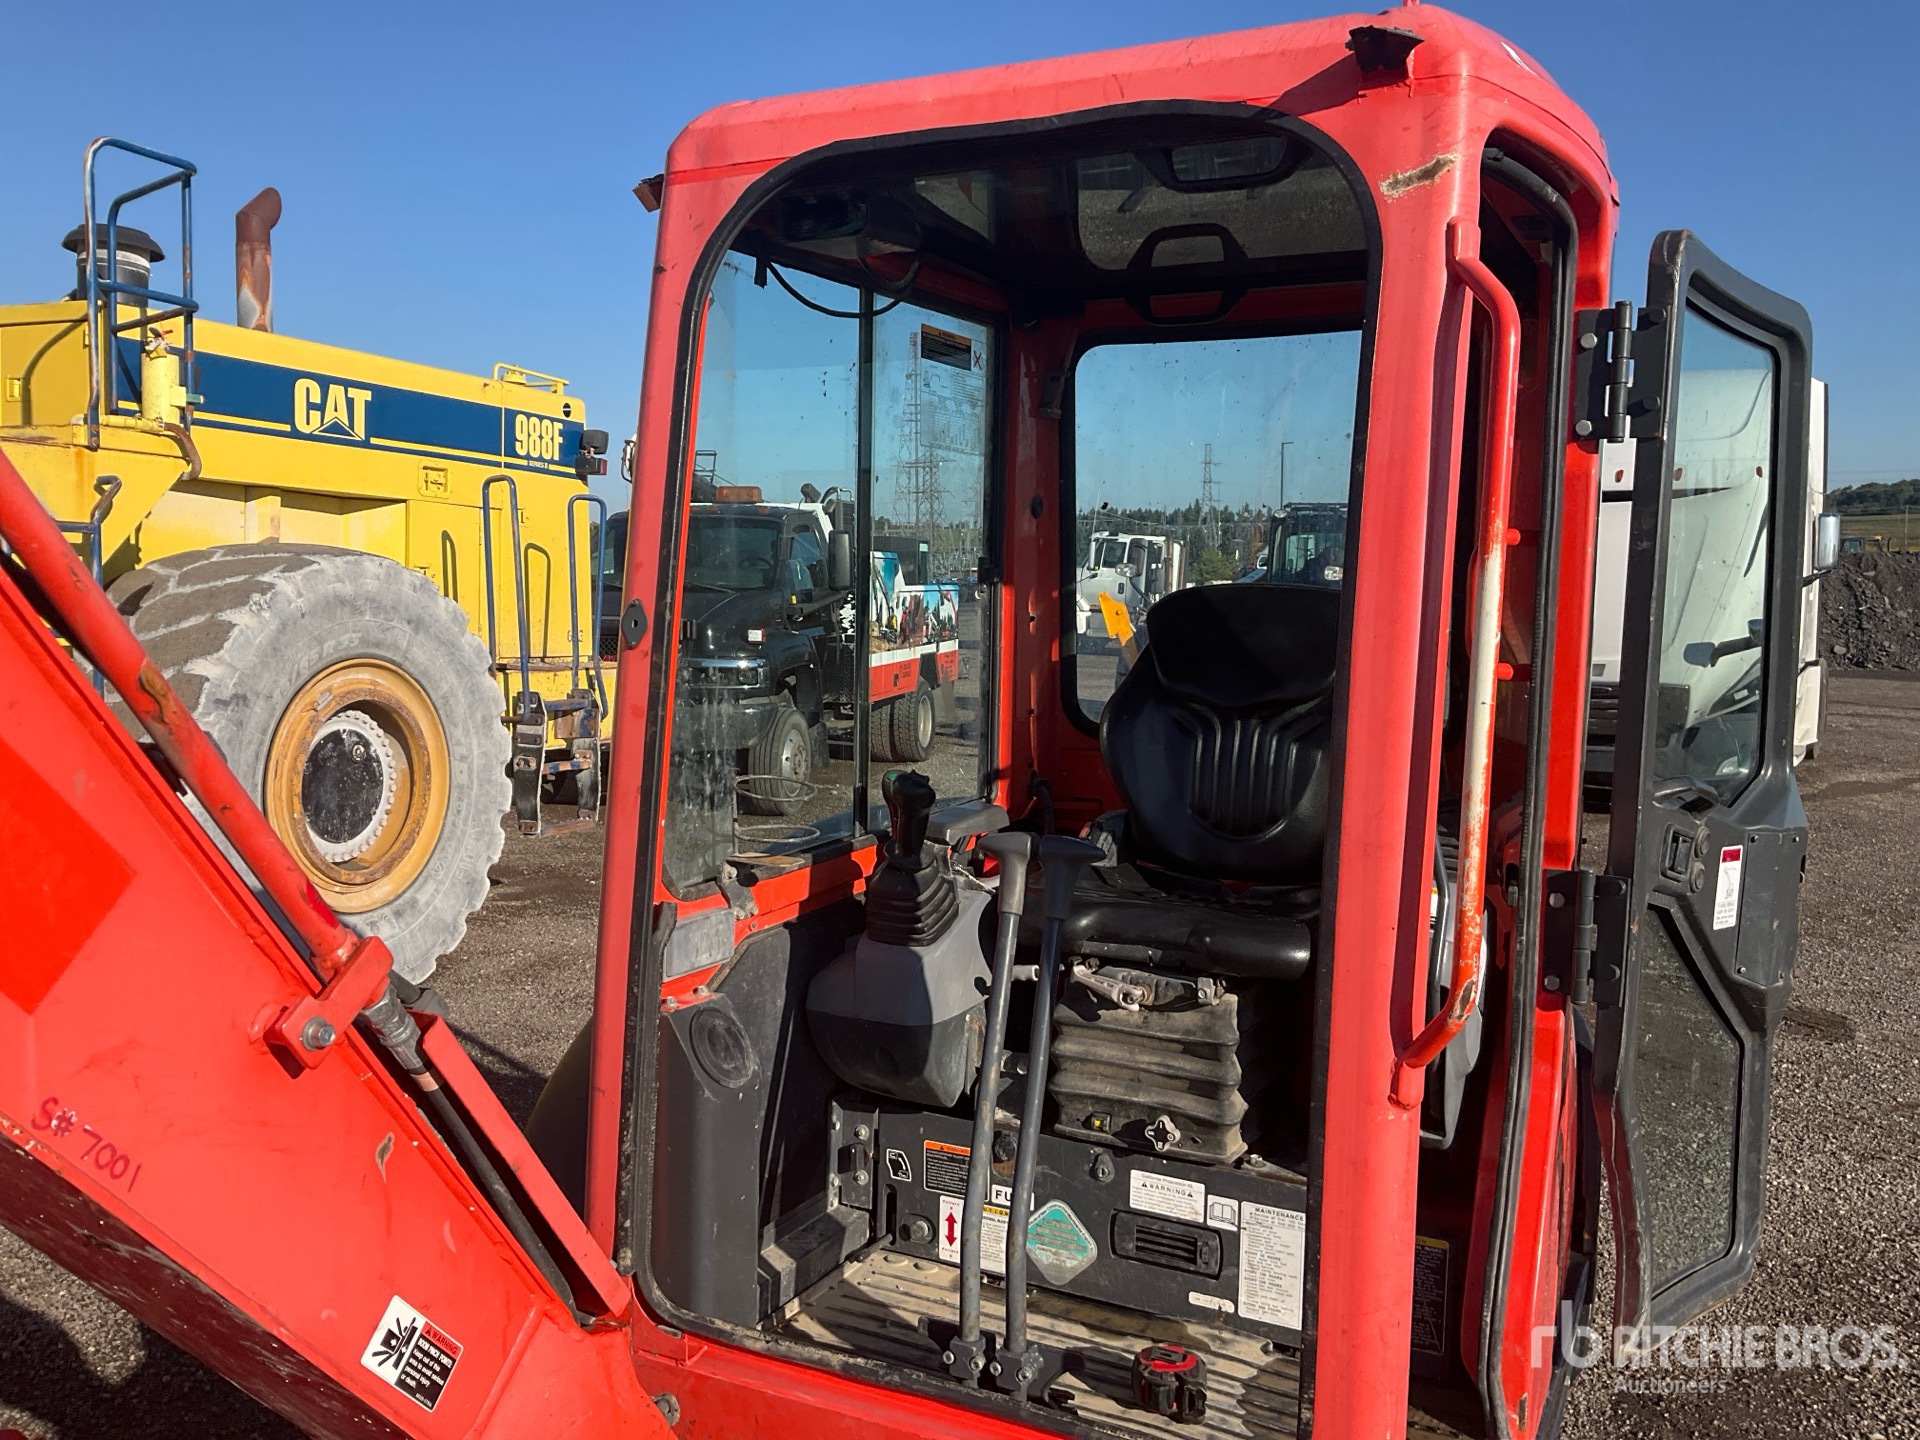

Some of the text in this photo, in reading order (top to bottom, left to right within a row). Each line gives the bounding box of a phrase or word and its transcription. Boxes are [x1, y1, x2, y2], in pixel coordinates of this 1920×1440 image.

[294, 378, 372, 440] CAT
[515, 414, 563, 461] 988F
[81, 1124, 142, 1193] 7001
[995, 1189, 1011, 1202] FU
[1149, 1183, 1187, 1196] WARNING
[1255, 1207, 1304, 1222] MAINTENANCE
[431, 1331, 457, 1355] WARNING
